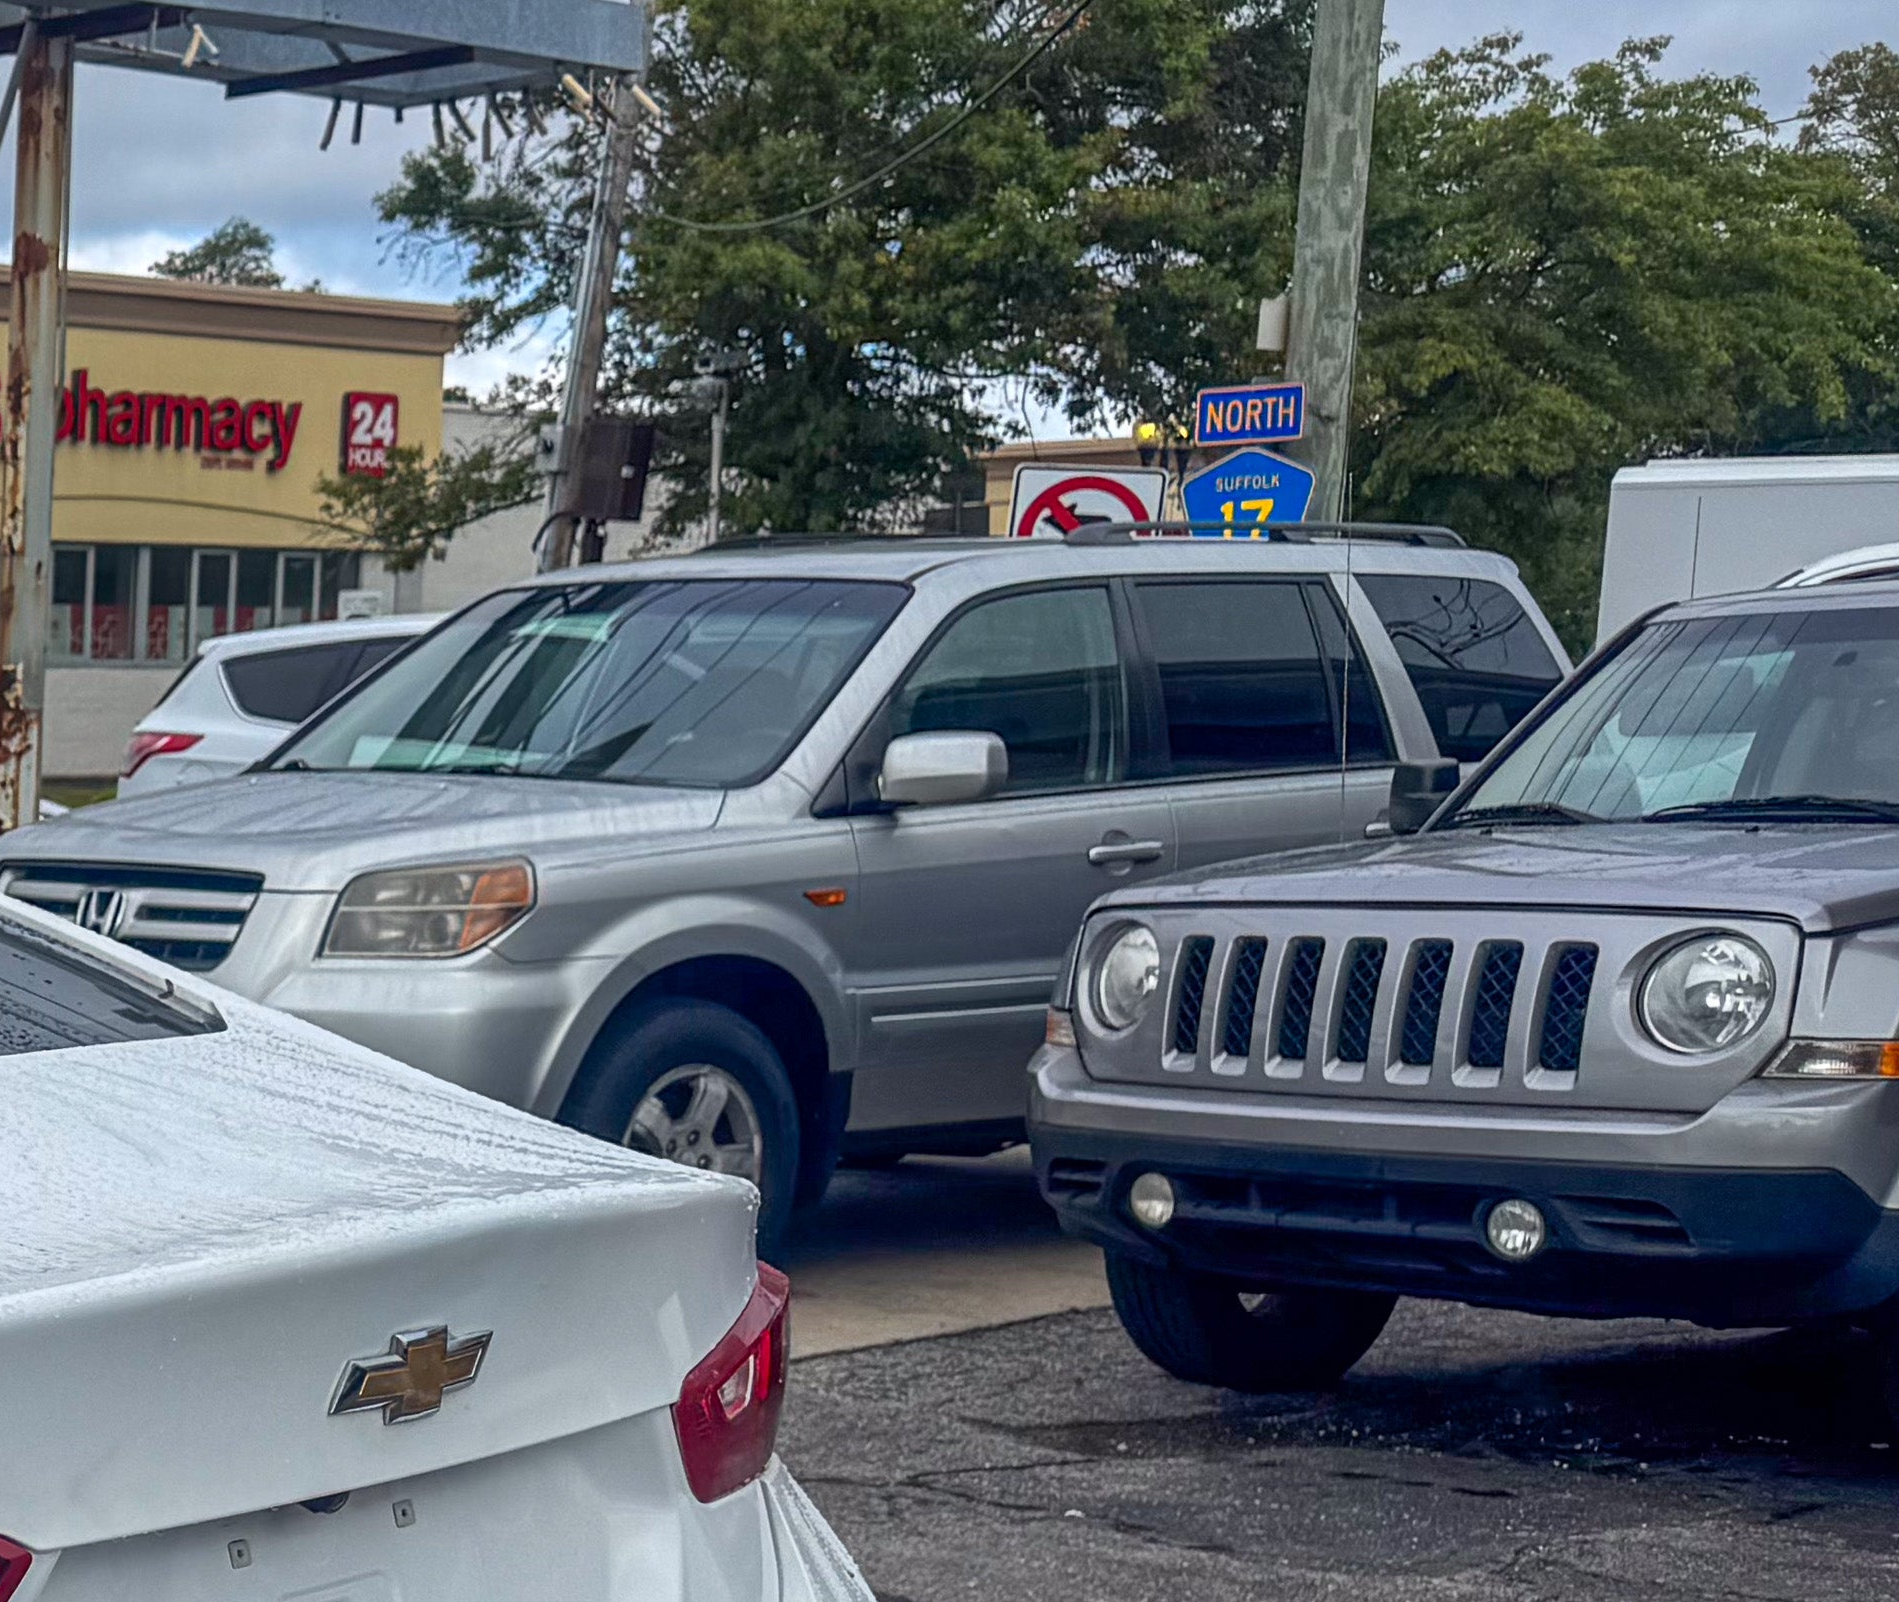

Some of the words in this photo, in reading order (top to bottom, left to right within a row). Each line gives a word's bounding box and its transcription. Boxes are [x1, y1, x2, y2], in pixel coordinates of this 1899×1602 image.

[350, 401, 395, 447] 24
[1205, 395, 1295, 434] NORTH
[1215, 473, 1280, 493] SUFFOLK
[1220, 498, 1274, 541] 17
